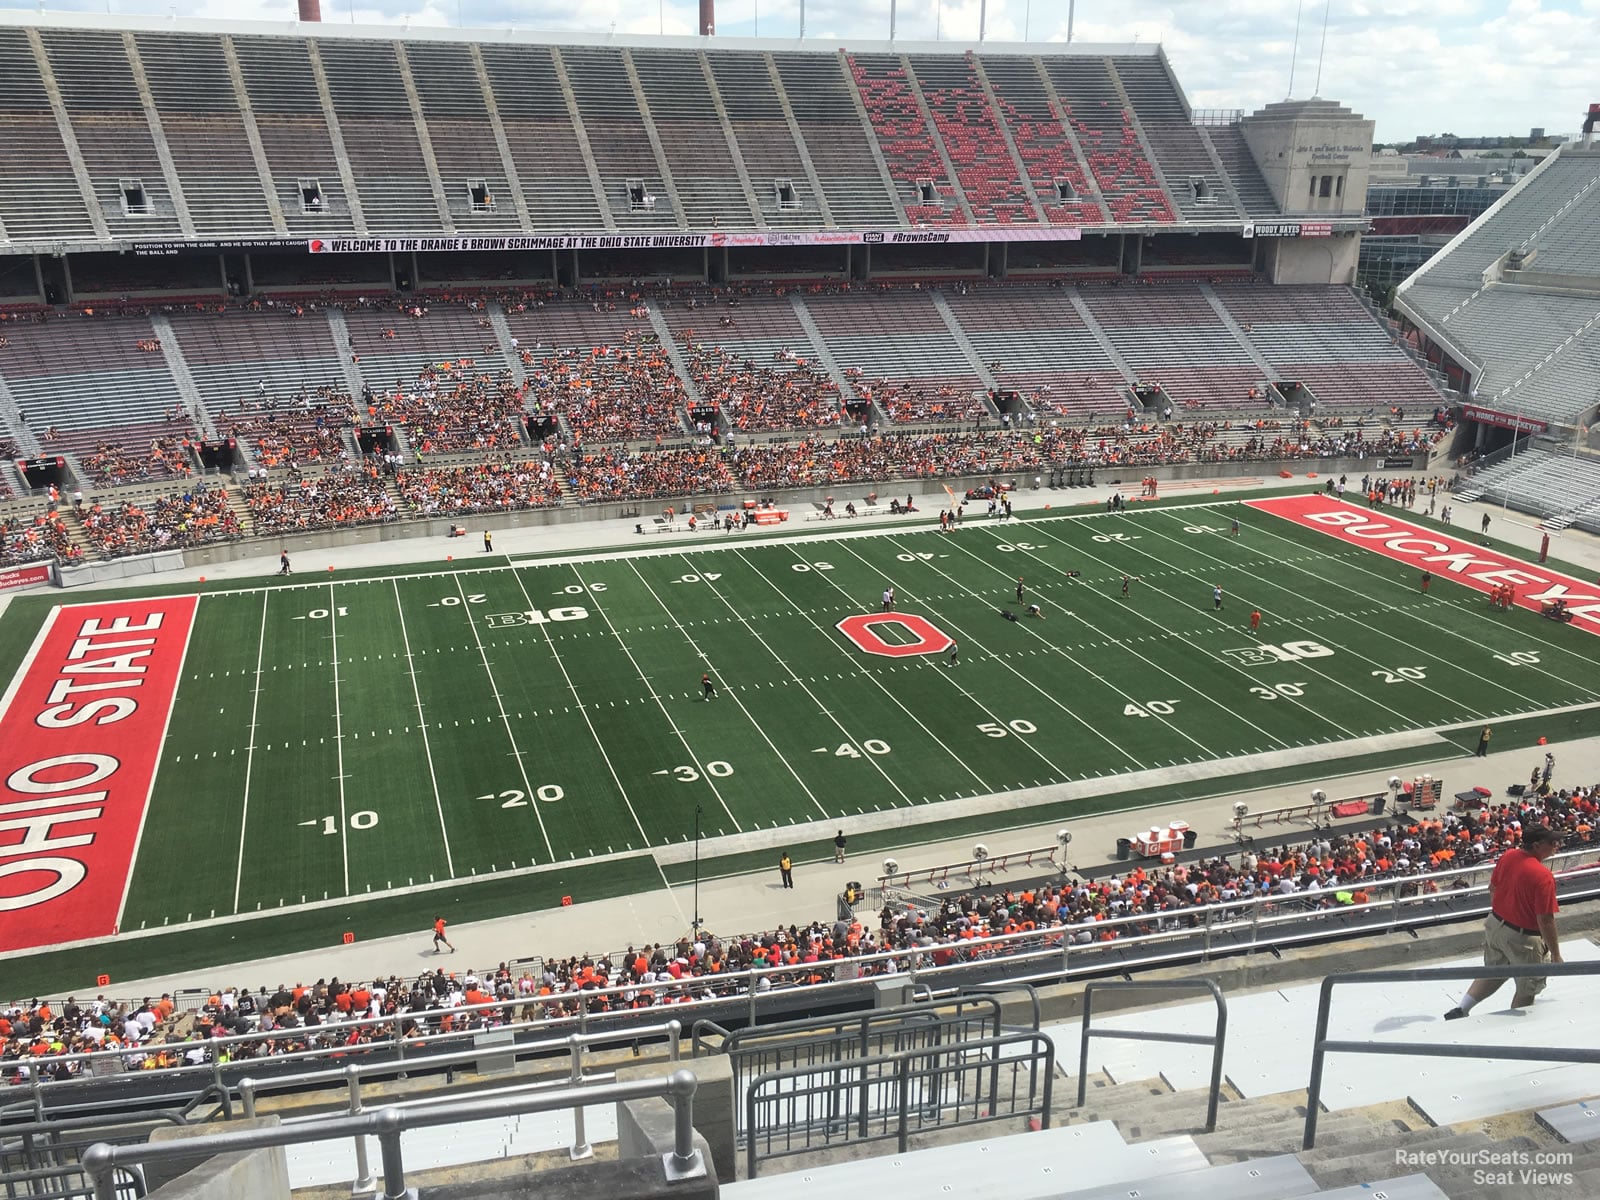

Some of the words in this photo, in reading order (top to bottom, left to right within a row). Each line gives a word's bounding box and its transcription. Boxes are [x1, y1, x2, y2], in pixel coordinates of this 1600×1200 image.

[332, 240, 381, 251] WELCOME
[384, 240, 396, 250] TO
[400, 240, 418, 250] THE
[421, 239, 459, 250] ORANGE
[462, 239, 468, 249] &
[471, 239, 506, 249] BROWN
[508, 238, 564, 249] SCRIMMAGE
[567, 238, 578, 248] AT
[581, 237, 597, 247] THE
[600, 237, 622, 247] OHIO
[624, 236, 651, 247] STATE
[652, 236, 706, 246] UNIVERSITY
[893, 233, 950, 243] #BrownsCamp
[1092, 533, 1136, 542] 20
[1184, 526, 1221, 534] 10
[996, 543, 1036, 552] 30
[896, 552, 935, 562] 40
[792, 562, 834, 573] 50
[681, 572, 722, 583] 40
[565, 582, 607, 594] 30
[441, 594, 487, 606] 20
[308, 607, 348, 619] 10
[835, 612, 955, 658] O
[1492, 652, 1540, 666] 10
[35, 611, 165, 729] STATE
[1372, 666, 1426, 683] 20
[1249, 683, 1304, 700] 30
[1123, 701, 1174, 718] 40
[976, 719, 1038, 738] 50
[834, 739, 891, 760] 40
[674, 760, 734, 782] 30
[499, 784, 564, 808] 20
[322, 810, 379, 834] 10
[0, 753, 121, 912] OHIO
